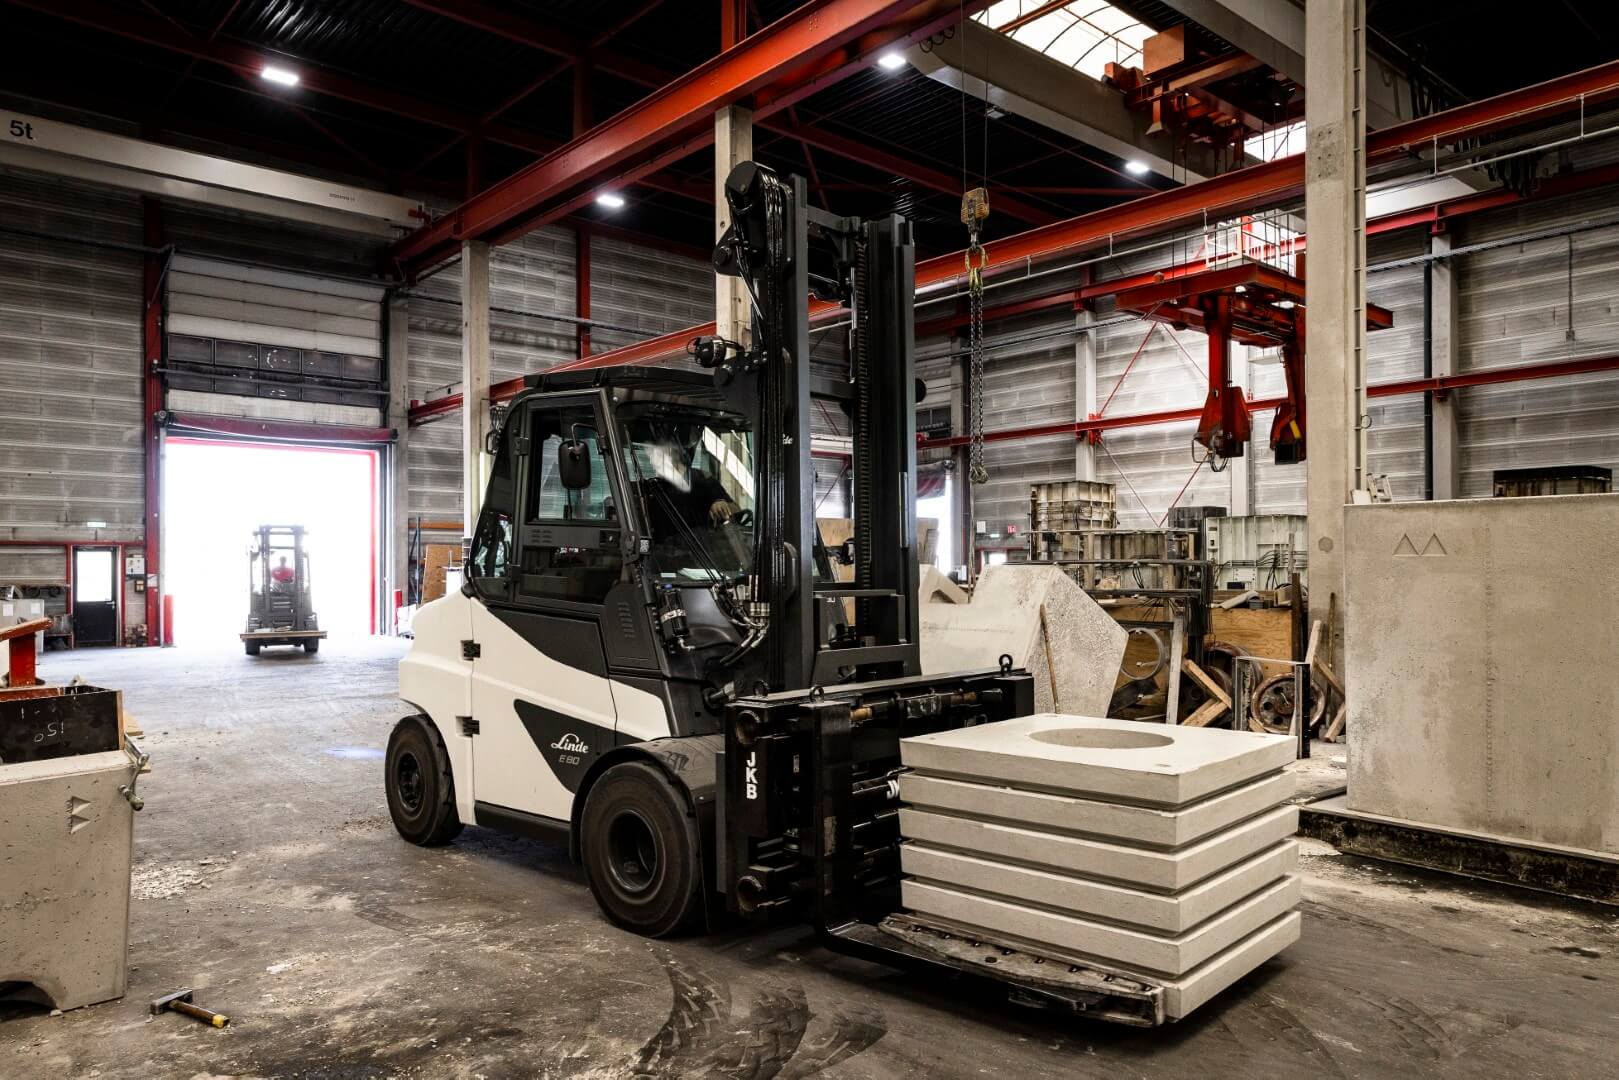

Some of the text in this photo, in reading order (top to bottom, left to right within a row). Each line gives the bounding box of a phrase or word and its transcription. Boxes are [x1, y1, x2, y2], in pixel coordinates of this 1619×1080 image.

[10, 120, 33, 139] 5t
[551, 733, 588, 753] Linde
[746, 751, 758, 799] JKB
